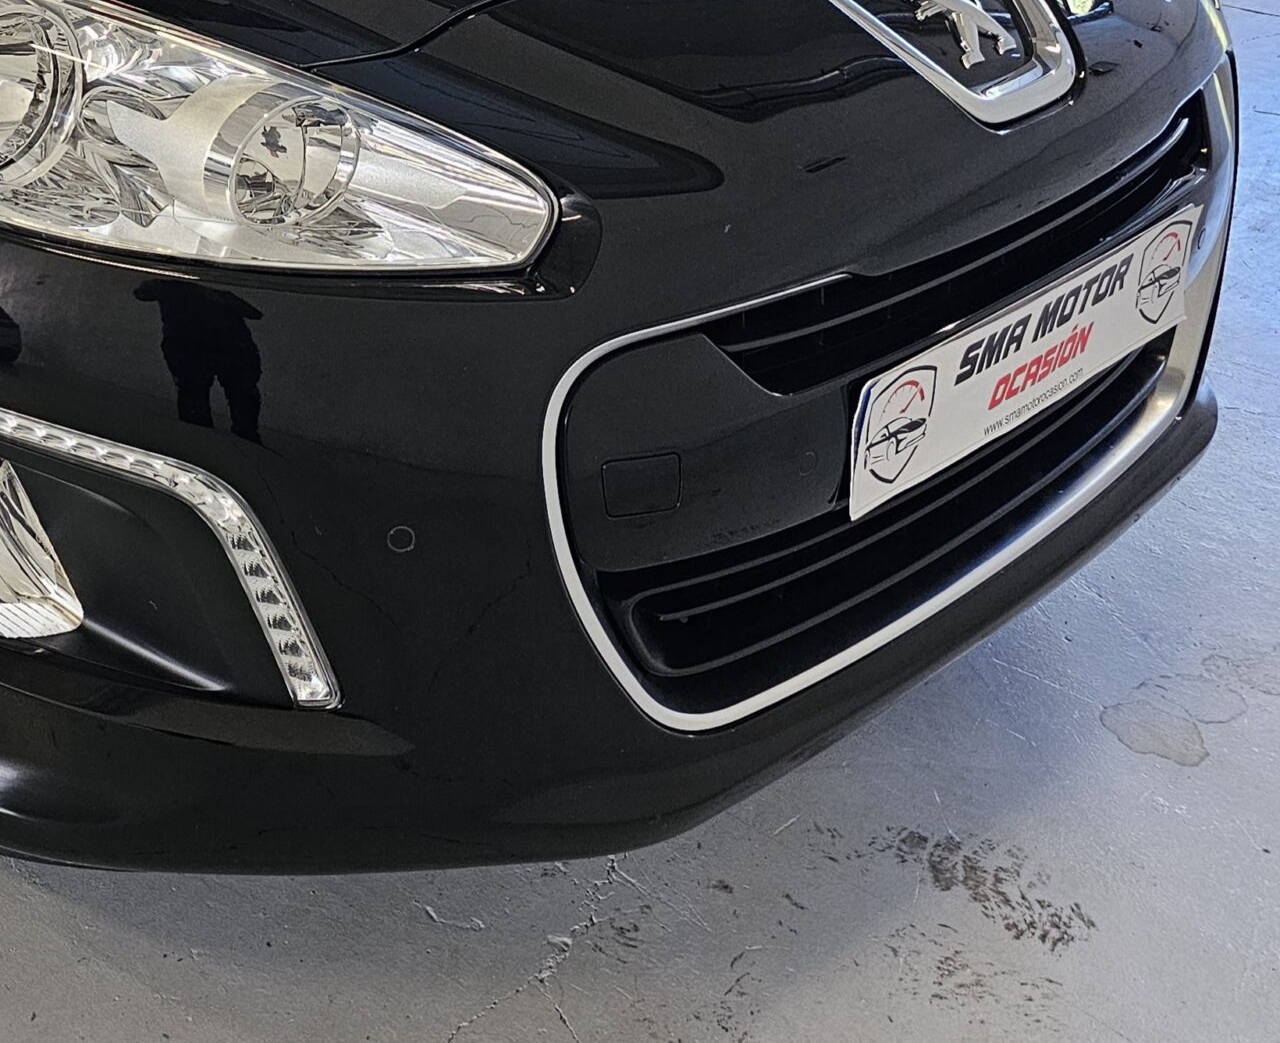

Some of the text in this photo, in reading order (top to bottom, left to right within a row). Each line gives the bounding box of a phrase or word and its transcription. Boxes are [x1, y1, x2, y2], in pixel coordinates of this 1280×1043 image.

[954, 253, 1134, 386] SMA MOTOR
[983, 368, 1084, 436] www.smamotorocasion.com
[988, 321, 1095, 411] OCASIÓN
